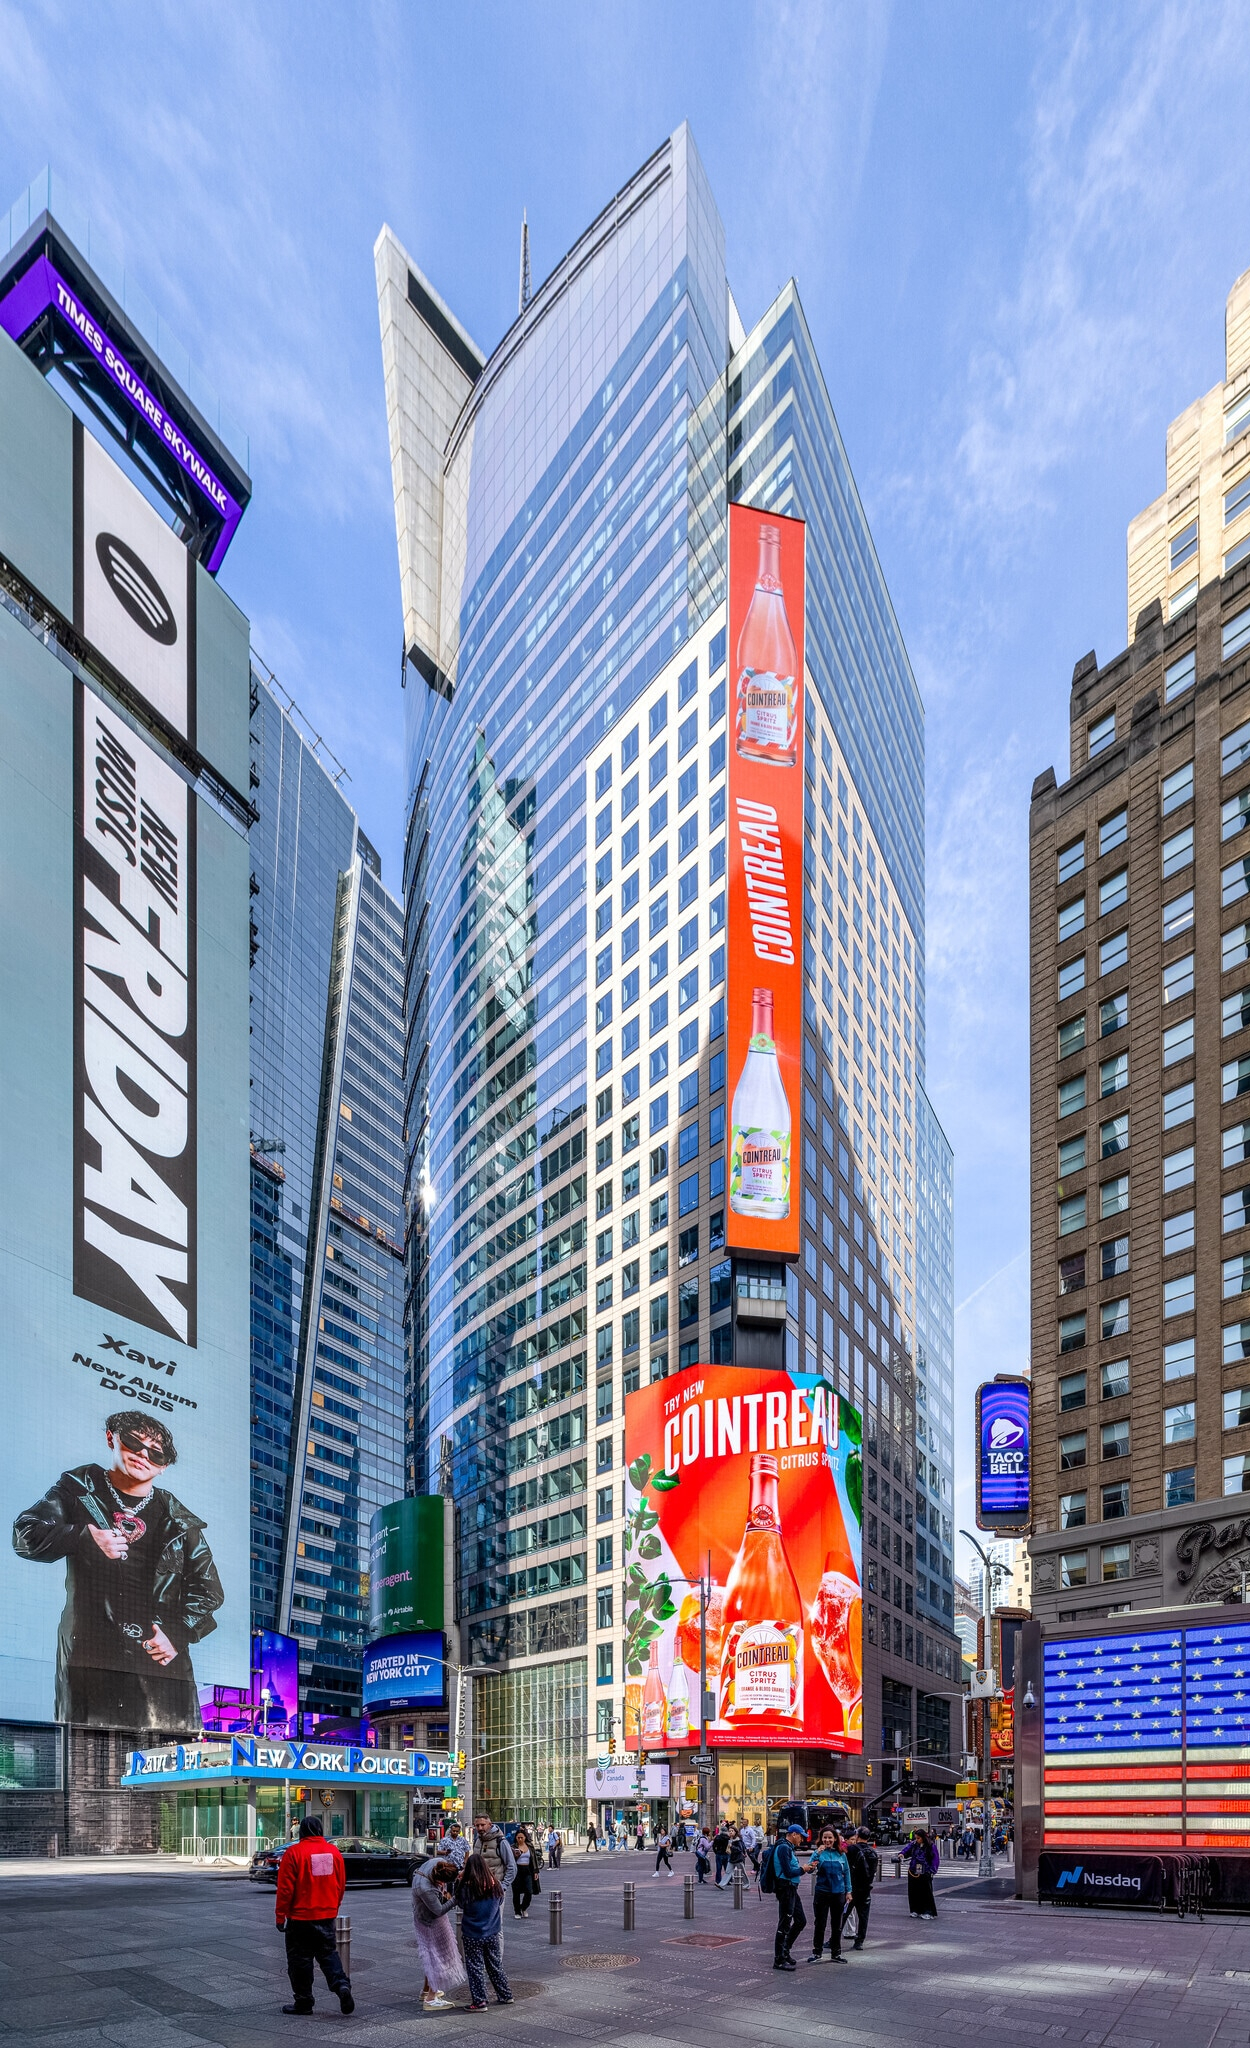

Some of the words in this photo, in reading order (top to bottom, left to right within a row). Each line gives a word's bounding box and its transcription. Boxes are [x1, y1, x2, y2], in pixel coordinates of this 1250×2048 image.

[57, 283, 103, 353] TIMES
[104, 346, 163, 429] SQUARE
[163, 421, 228, 511] SKYWALK
[747, 693, 787, 706] COINTREAU
[756, 709, 777, 719] CITRUS
[95, 715, 137, 868] MUSIC
[140, 796, 178, 915] NEW
[735, 797, 795, 966] COINTREAU
[83, 835, 188, 1345] FRIDAY
[742, 1149, 781, 1164] COINTREAU
[97, 1333, 178, 1377] Xavi
[72, 1352, 126, 1382] New
[127, 1375, 198, 1410] Album
[99, 1376, 175, 1413] DOSIS
[664, 1394, 681, 1416] TRY
[683, 1380, 705, 1403] NEW
[664, 1386, 840, 1477] COINTREAU
[780, 1452, 819, 1470] CITRUS
[821, 1453, 840, 1471] SPRITZ
[987, 1452, 1025, 1464] TACO
[990, 1463, 1025, 1475] BELL
[370, 1655, 405, 1672] STARTED
[406, 1654, 418, 1665] IN
[737, 1645, 789, 1669] COINTREAU
[366, 1671, 378, 1685] NEW
[379, 1667, 402, 1680] YORK
[404, 1665, 431, 1677] CITY
[749, 1670, 777, 1678] CITRUS
[750, 1677, 776, 1685] SPRITZ
[231, 1736, 286, 1768] NEW
[287, 1742, 343, 1771] YORK
[346, 1747, 407, 1775] POLICE
[412, 1752, 453, 1777] DEPT
[612, 1754, 637, 1765] AT&T
[830, 1781, 855, 1794] TOURO
[1083, 1872, 1141, 1891] Nasdaq
